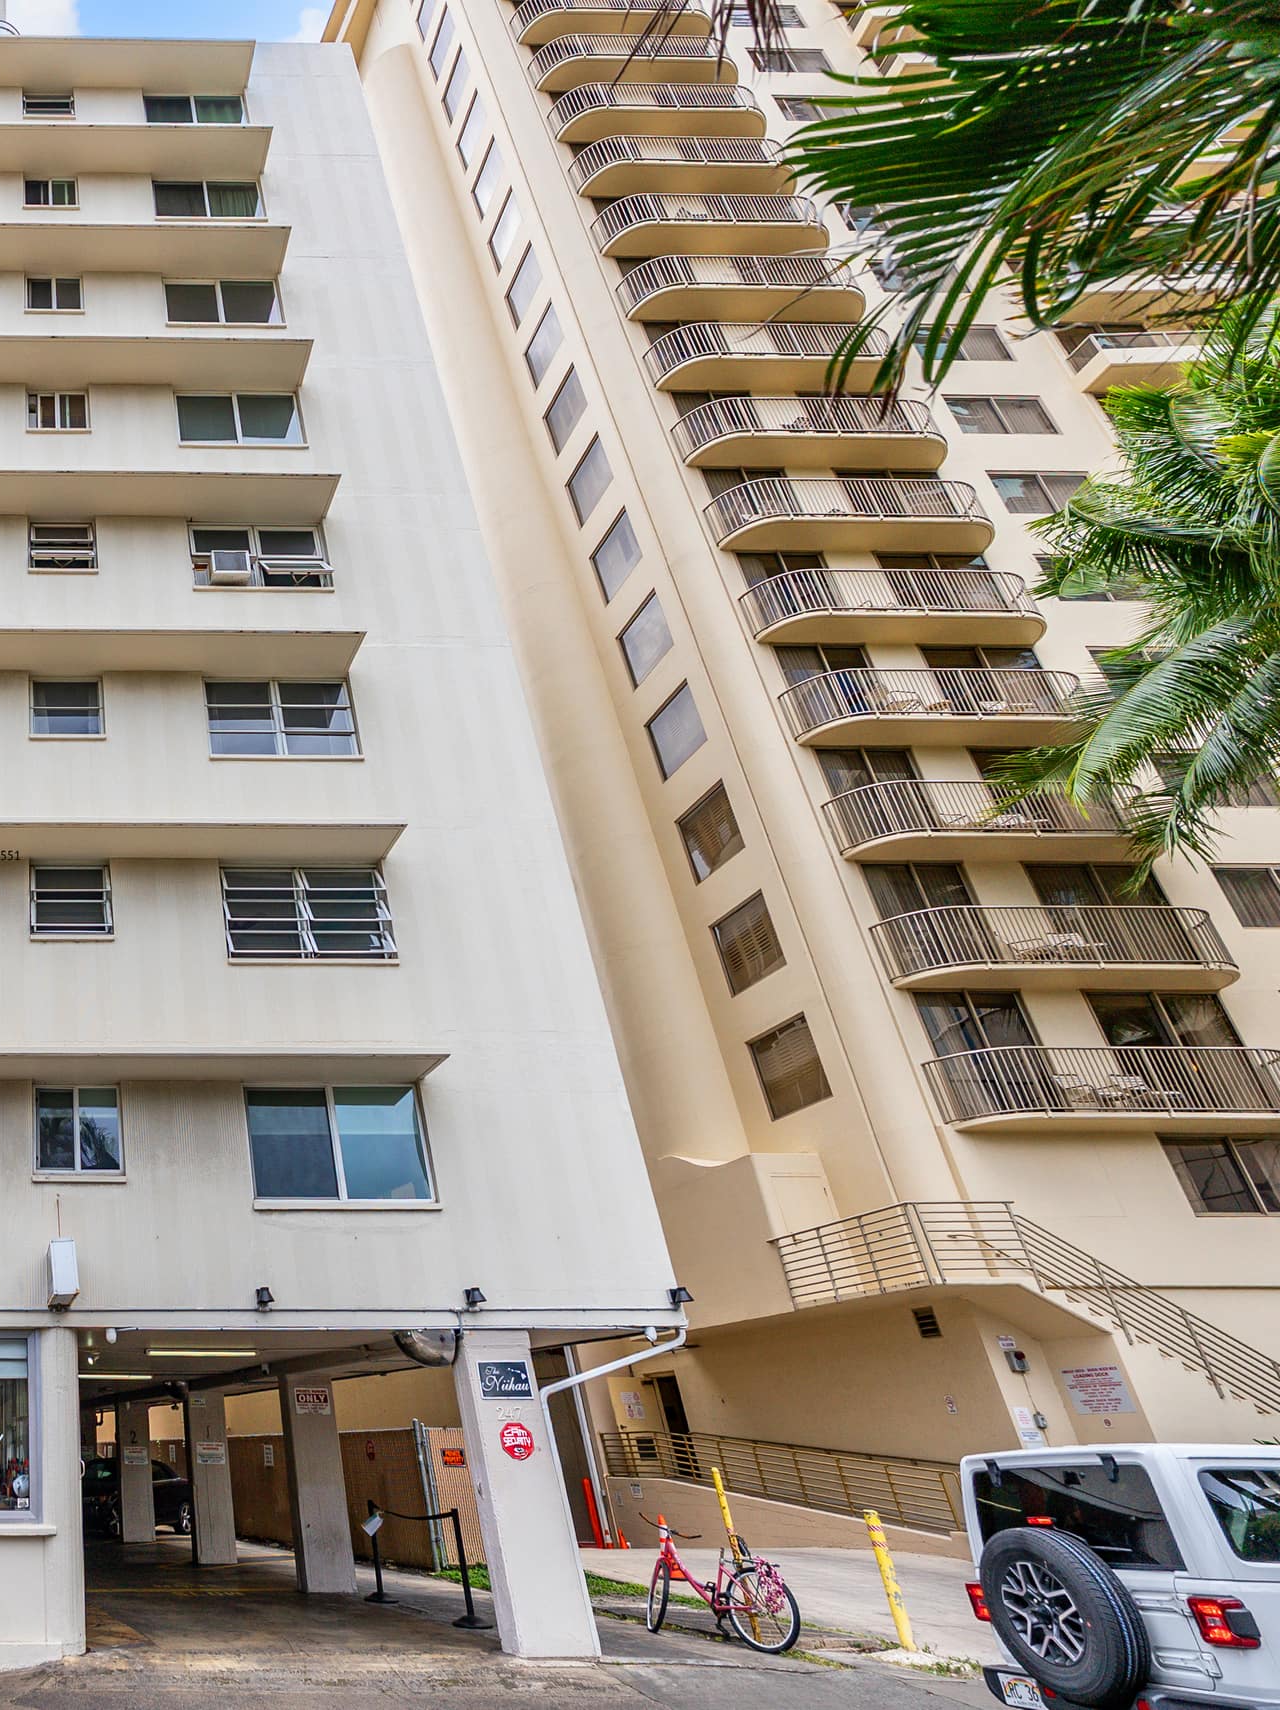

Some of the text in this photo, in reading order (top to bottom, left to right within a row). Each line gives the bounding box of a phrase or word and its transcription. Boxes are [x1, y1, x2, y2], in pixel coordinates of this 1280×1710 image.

[485, 1366, 500, 1375] The
[482, 1375, 530, 1391] Niihau
[298, 1394, 325, 1403] ONLY
[130, 1430, 138, 1444] 2
